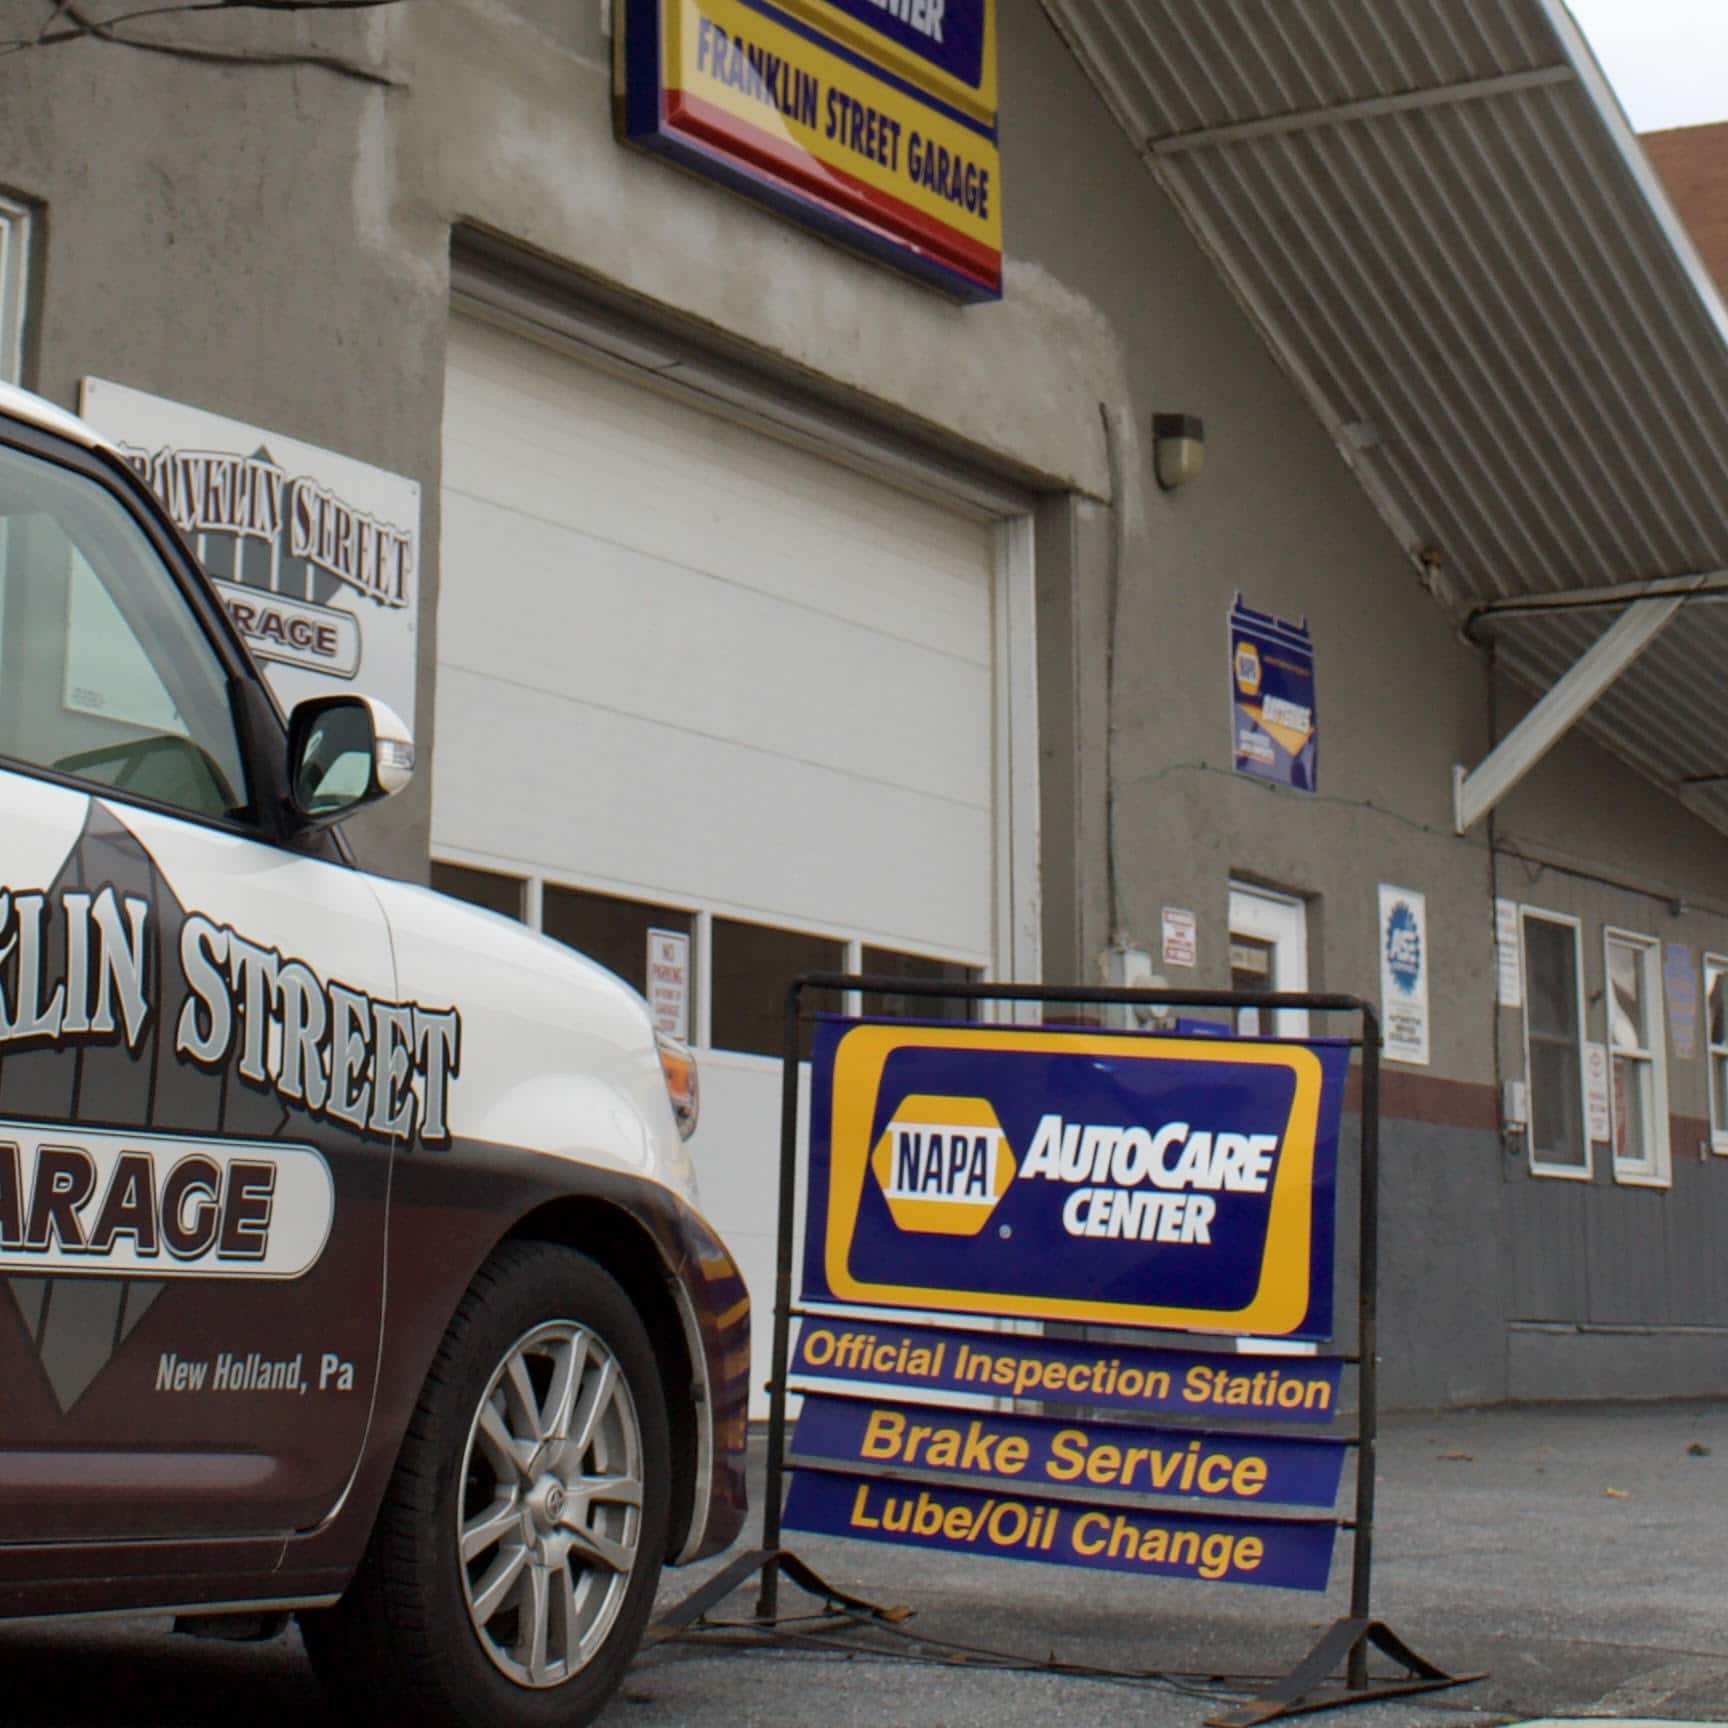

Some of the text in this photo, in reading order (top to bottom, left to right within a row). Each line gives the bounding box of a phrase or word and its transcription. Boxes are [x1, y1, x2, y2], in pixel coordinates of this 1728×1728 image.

[697, 15, 989, 221] FRANKLIN STREET GARAGE
[117, 441, 413, 610] ANKLIN STREET
[225, 599, 338, 658] RAGE
[175, 911, 462, 1143] STREET
[896, 1130, 989, 1198] NAPA
[1019, 1114, 1278, 1193] AUTOCARE
[1062, 1188, 1217, 1245] CENTER
[155, 1352, 354, 1395] New Holland, Pa
[802, 1328, 1332, 1410] Official Inspection Station
[860, 1409, 1268, 1497] Brake Service
[849, 1484, 1265, 1579] Lube/Oil Change
